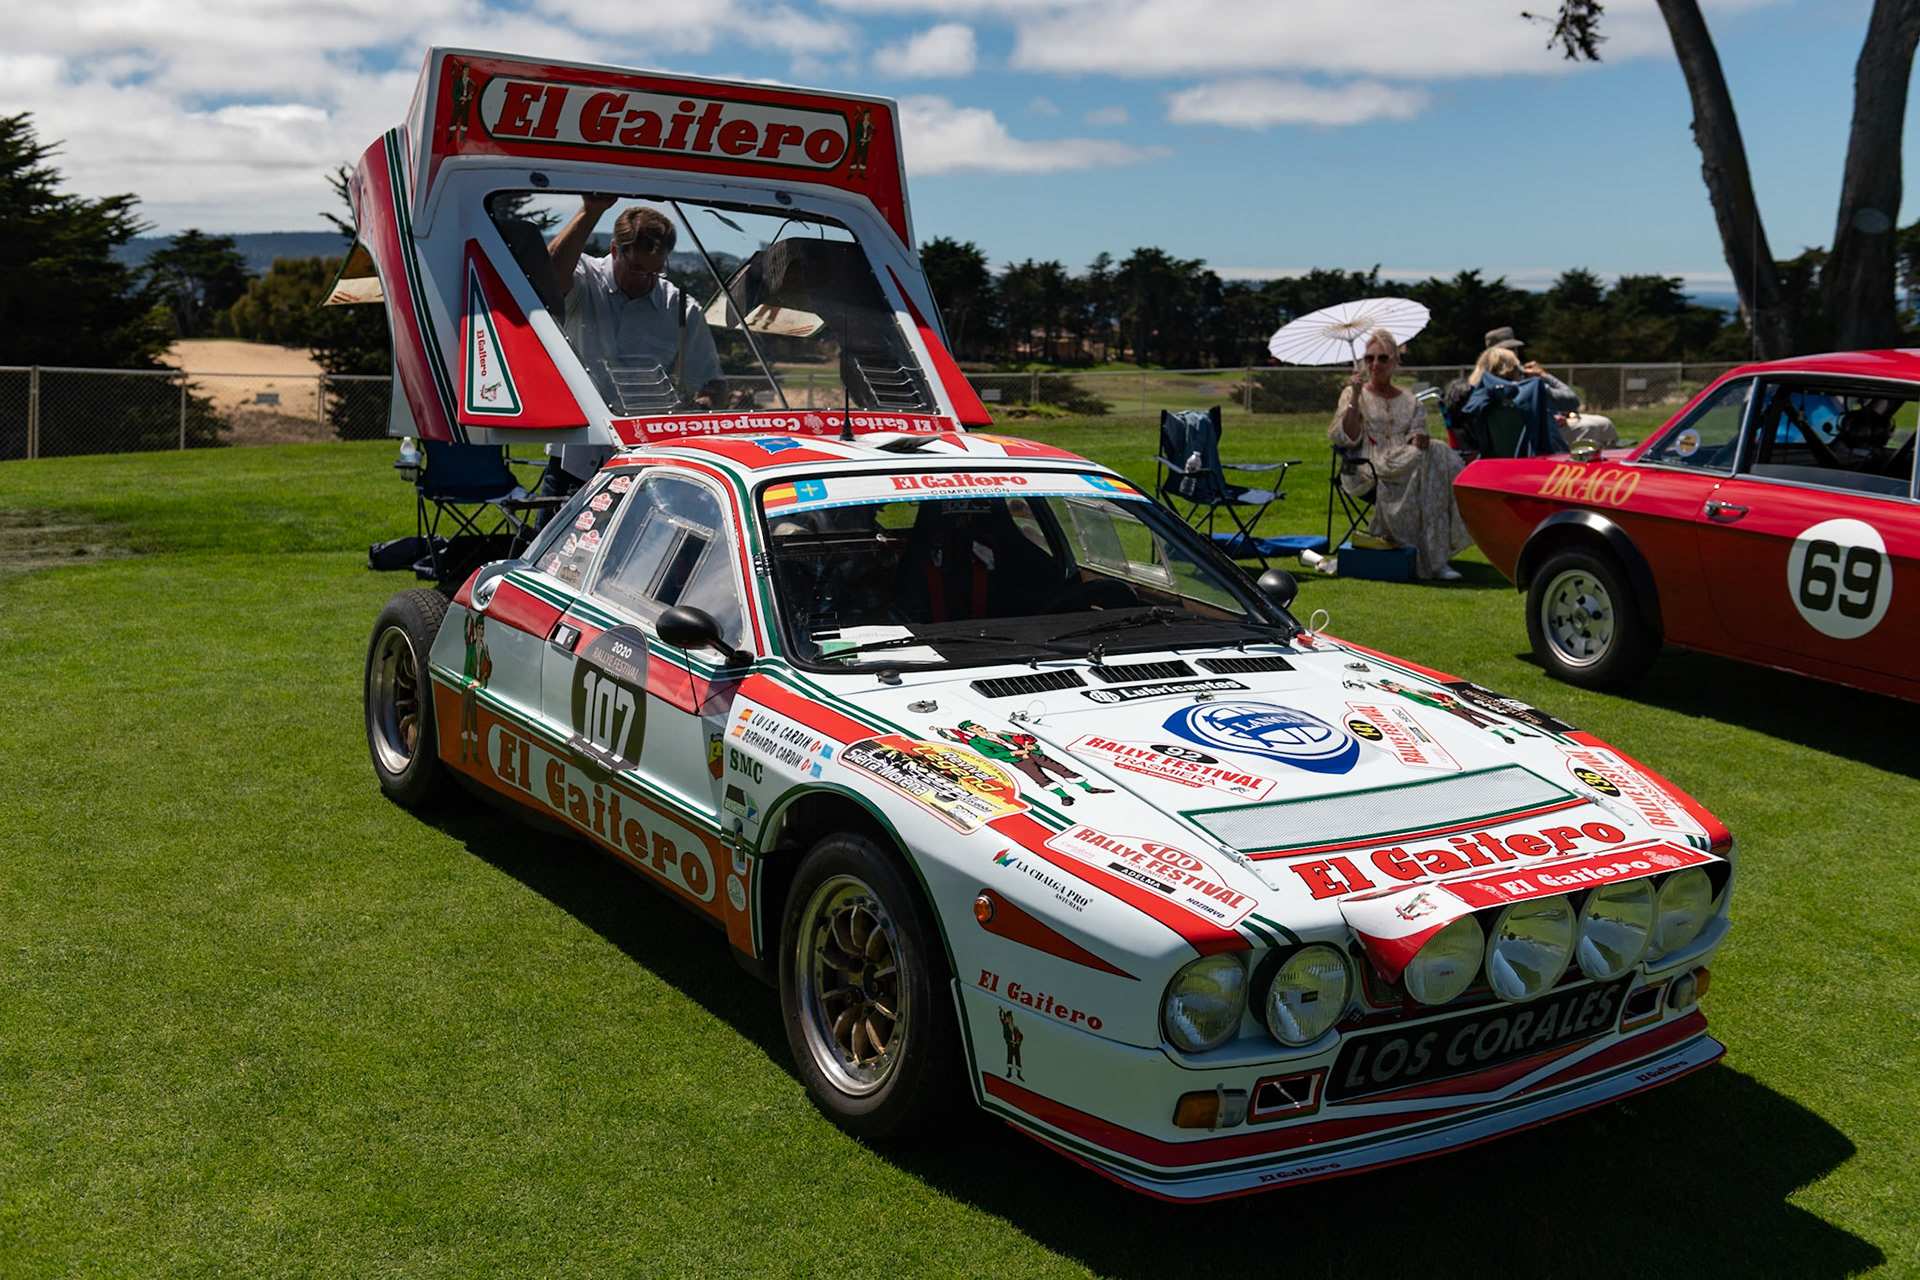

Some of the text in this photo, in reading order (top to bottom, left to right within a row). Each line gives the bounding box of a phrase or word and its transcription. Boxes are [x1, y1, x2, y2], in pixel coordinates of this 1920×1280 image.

[492, 81, 847, 166] El Gaitero
[476, 329, 487, 377] El Gaitero
[646, 417, 801, 436] Competicion
[914, 419, 931, 432] El
[890, 474, 1028, 490] El Gaitero
[931, 487, 1011, 496] COMPETICIÓN
[1538, 463, 1641, 506] DRAGO
[1801, 539, 1882, 620] 69
[592, 647, 613, 667] RALLYE
[612, 655, 640, 681] FESTIVAL
[611, 641, 633, 659] 2020
[1119, 679, 1241, 700] Lubricantes
[583, 670, 636, 763] 107
[751, 713, 780, 735] LUISA
[779, 726, 813, 750] CARDIN
[729, 748, 763, 785] SMC
[742, 729, 778, 756] BERNARDO
[775, 746, 804, 768] CARDIN
[939, 751, 998, 781] Revival
[1085, 737, 1157, 762] RALLYE
[1161, 756, 1264, 790] FESTIVAL
[1164, 745, 1203, 763] 92
[843, 748, 879, 771] Sierra
[877, 761, 929, 796] Morena
[909, 744, 1005, 792] Legend
[1113, 755, 1217, 786] TRASMIERA
[1565, 750, 1638, 790] FESTIVAL
[1577, 771, 1617, 793] 136
[498, 727, 709, 896] El Gaitero
[1622, 789, 1680, 828] RALLYE
[1073, 828, 1246, 910] RALLYE FESTIVAL
[1149, 844, 1197, 871] 100
[1288, 821, 1627, 900] El Gaitero
[1016, 861, 1030, 874] LA
[1028, 867, 1070, 897] CHALGA
[1120, 868, 1163, 890] ADELMA
[1499, 859, 1652, 896] El Gaitero
[1054, 893, 1083, 913] ASTURIAS
[978, 968, 1104, 1031] El Gaitero
[1345, 984, 1621, 1089] LOS CORALES
[1636, 1059, 1689, 1084] El Gaitero
[1258, 1163, 1341, 1183] El Gaitero
